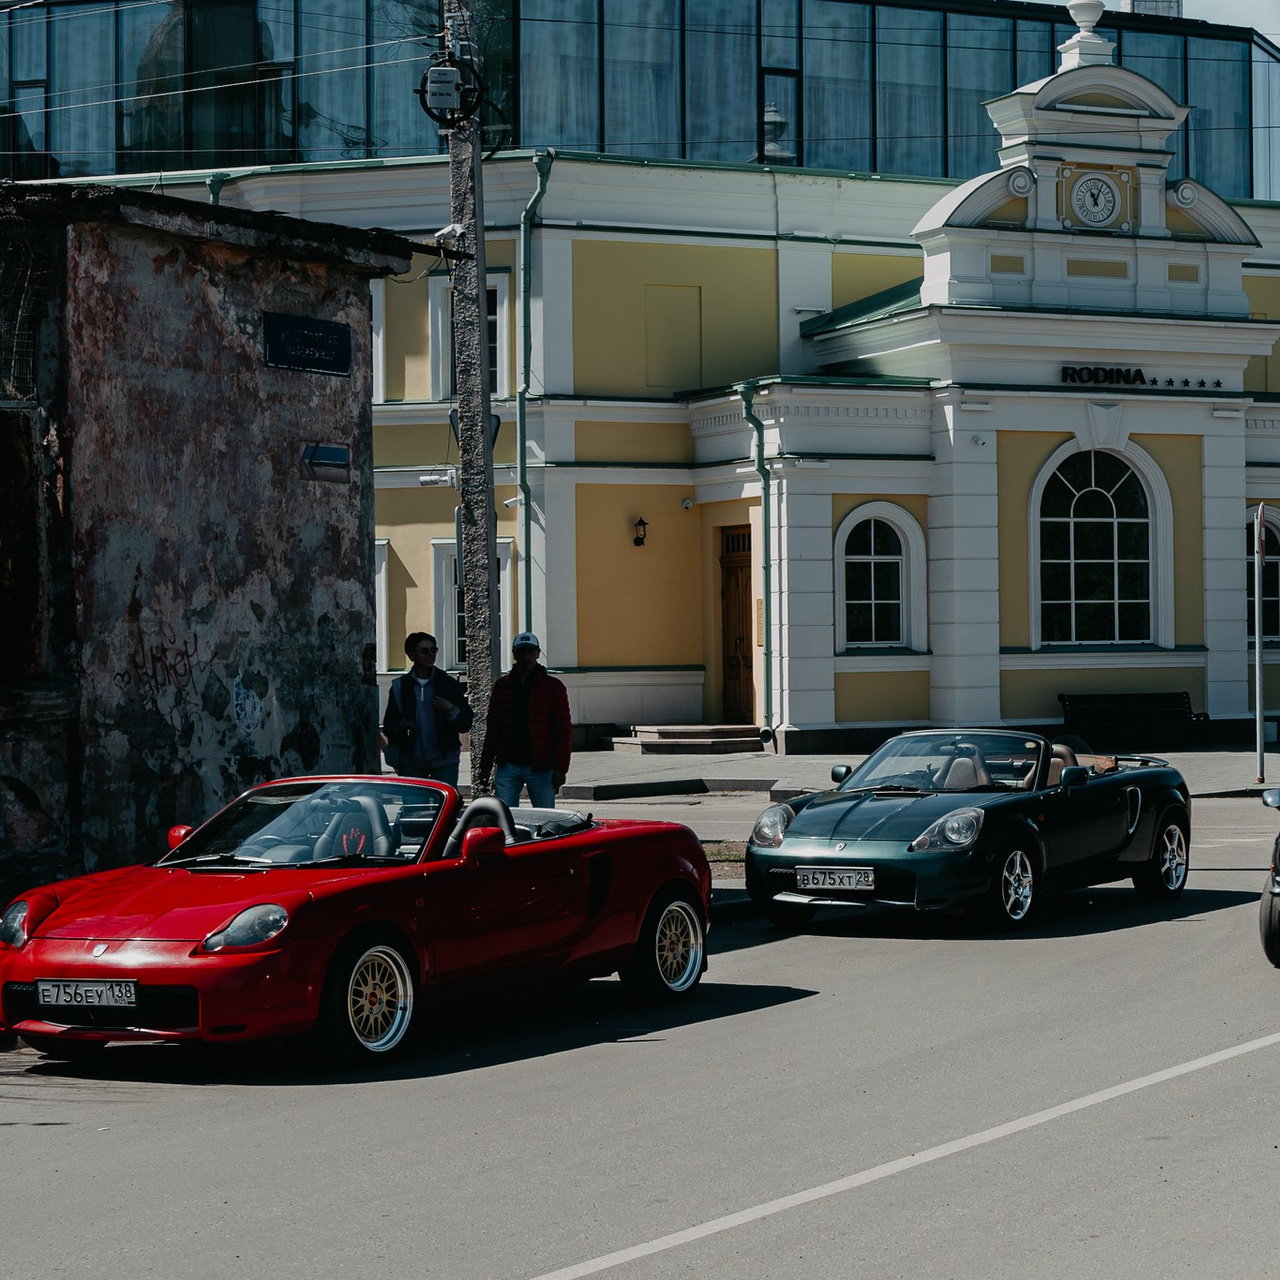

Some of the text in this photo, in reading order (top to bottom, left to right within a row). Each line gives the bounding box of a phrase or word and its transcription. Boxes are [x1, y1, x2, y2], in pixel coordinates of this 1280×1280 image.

[1060, 366, 1147, 385] RODINA
[41, 983, 133, 1004] Е756ЕУ 138
